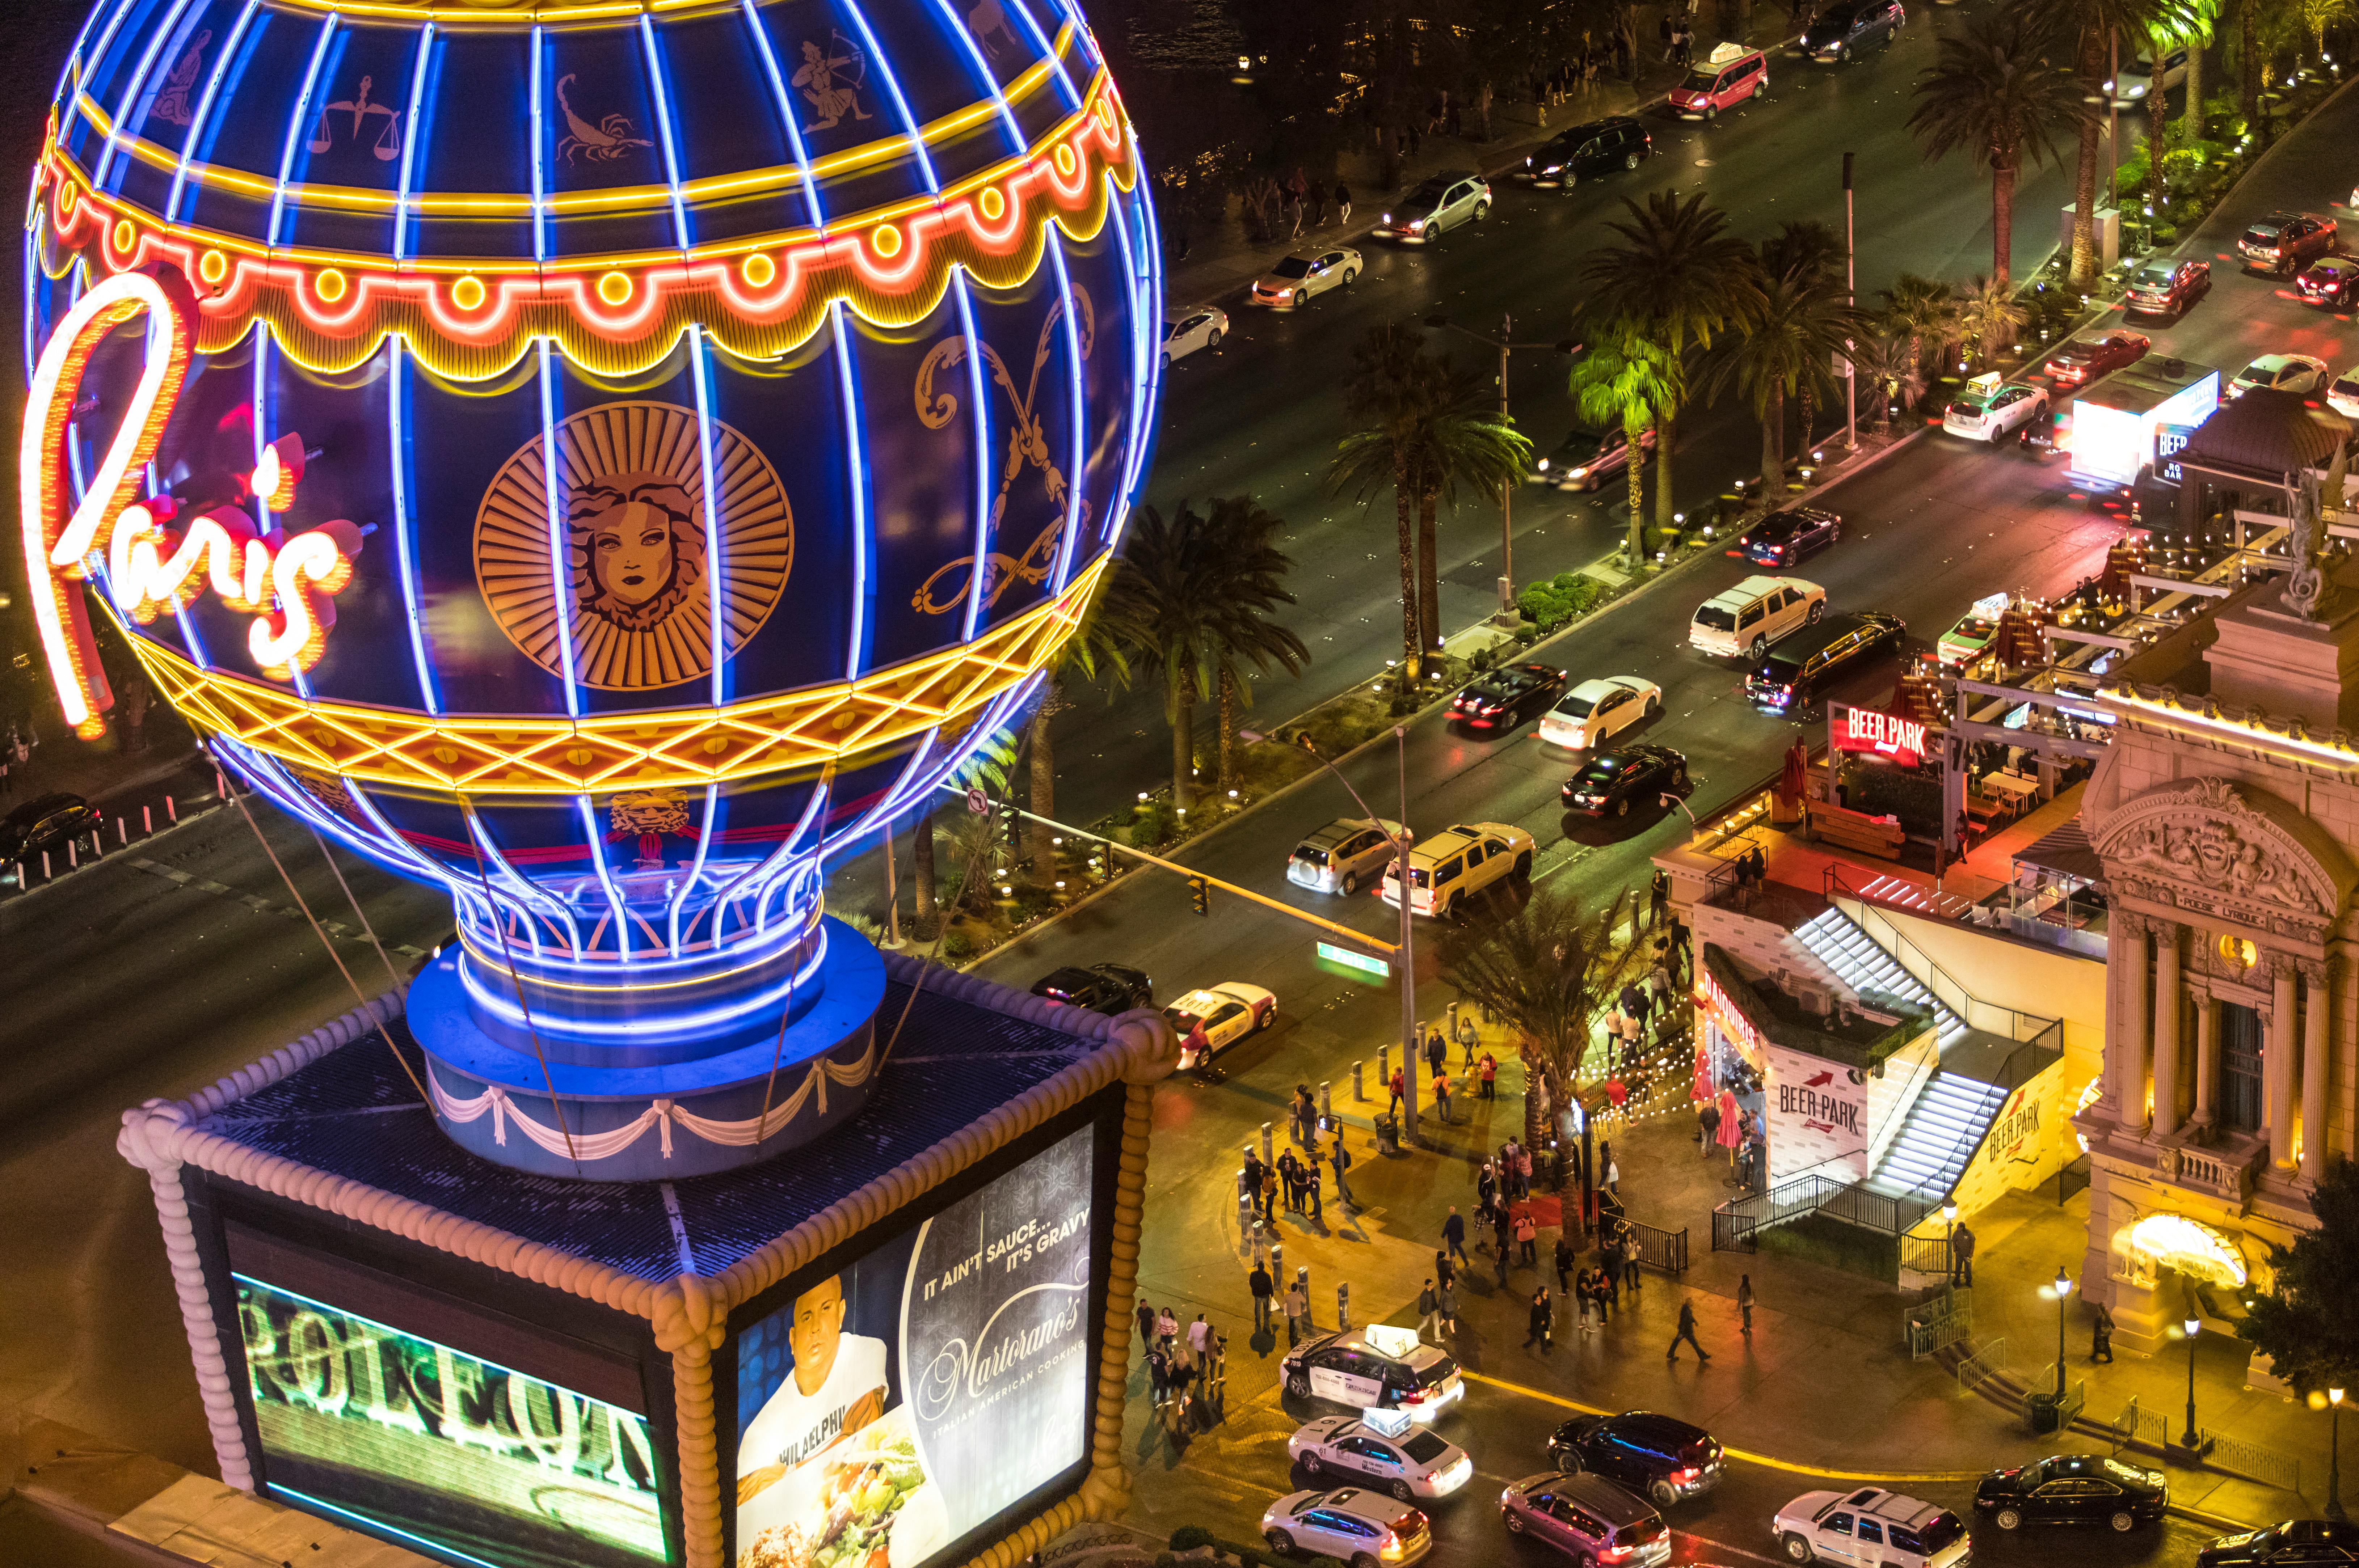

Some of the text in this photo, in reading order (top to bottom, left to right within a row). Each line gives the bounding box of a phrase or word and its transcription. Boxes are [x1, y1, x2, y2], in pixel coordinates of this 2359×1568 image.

[19, 267, 349, 733] Paris
[2164, 469, 2182, 480] BAR
[1848, 707, 1926, 757] BEER PARK
[1704, 970, 1756, 1051] DAIQUIRIS
[1780, 1083, 1859, 1135] BEER PARK
[1990, 1119, 2013, 1163] BEER
[2017, 1101, 2040, 1138] PARK
[924, 1218, 1051, 1301] IT AIN'T SAUCE...
[1006, 1207, 1090, 1274] IT'S GRAVY
[917, 1256, 1090, 1422] Martorano's
[932, 1339, 1085, 1440] ITALIAN AMERICAN COOKING
[1362, 1463, 1382, 1475] Western
